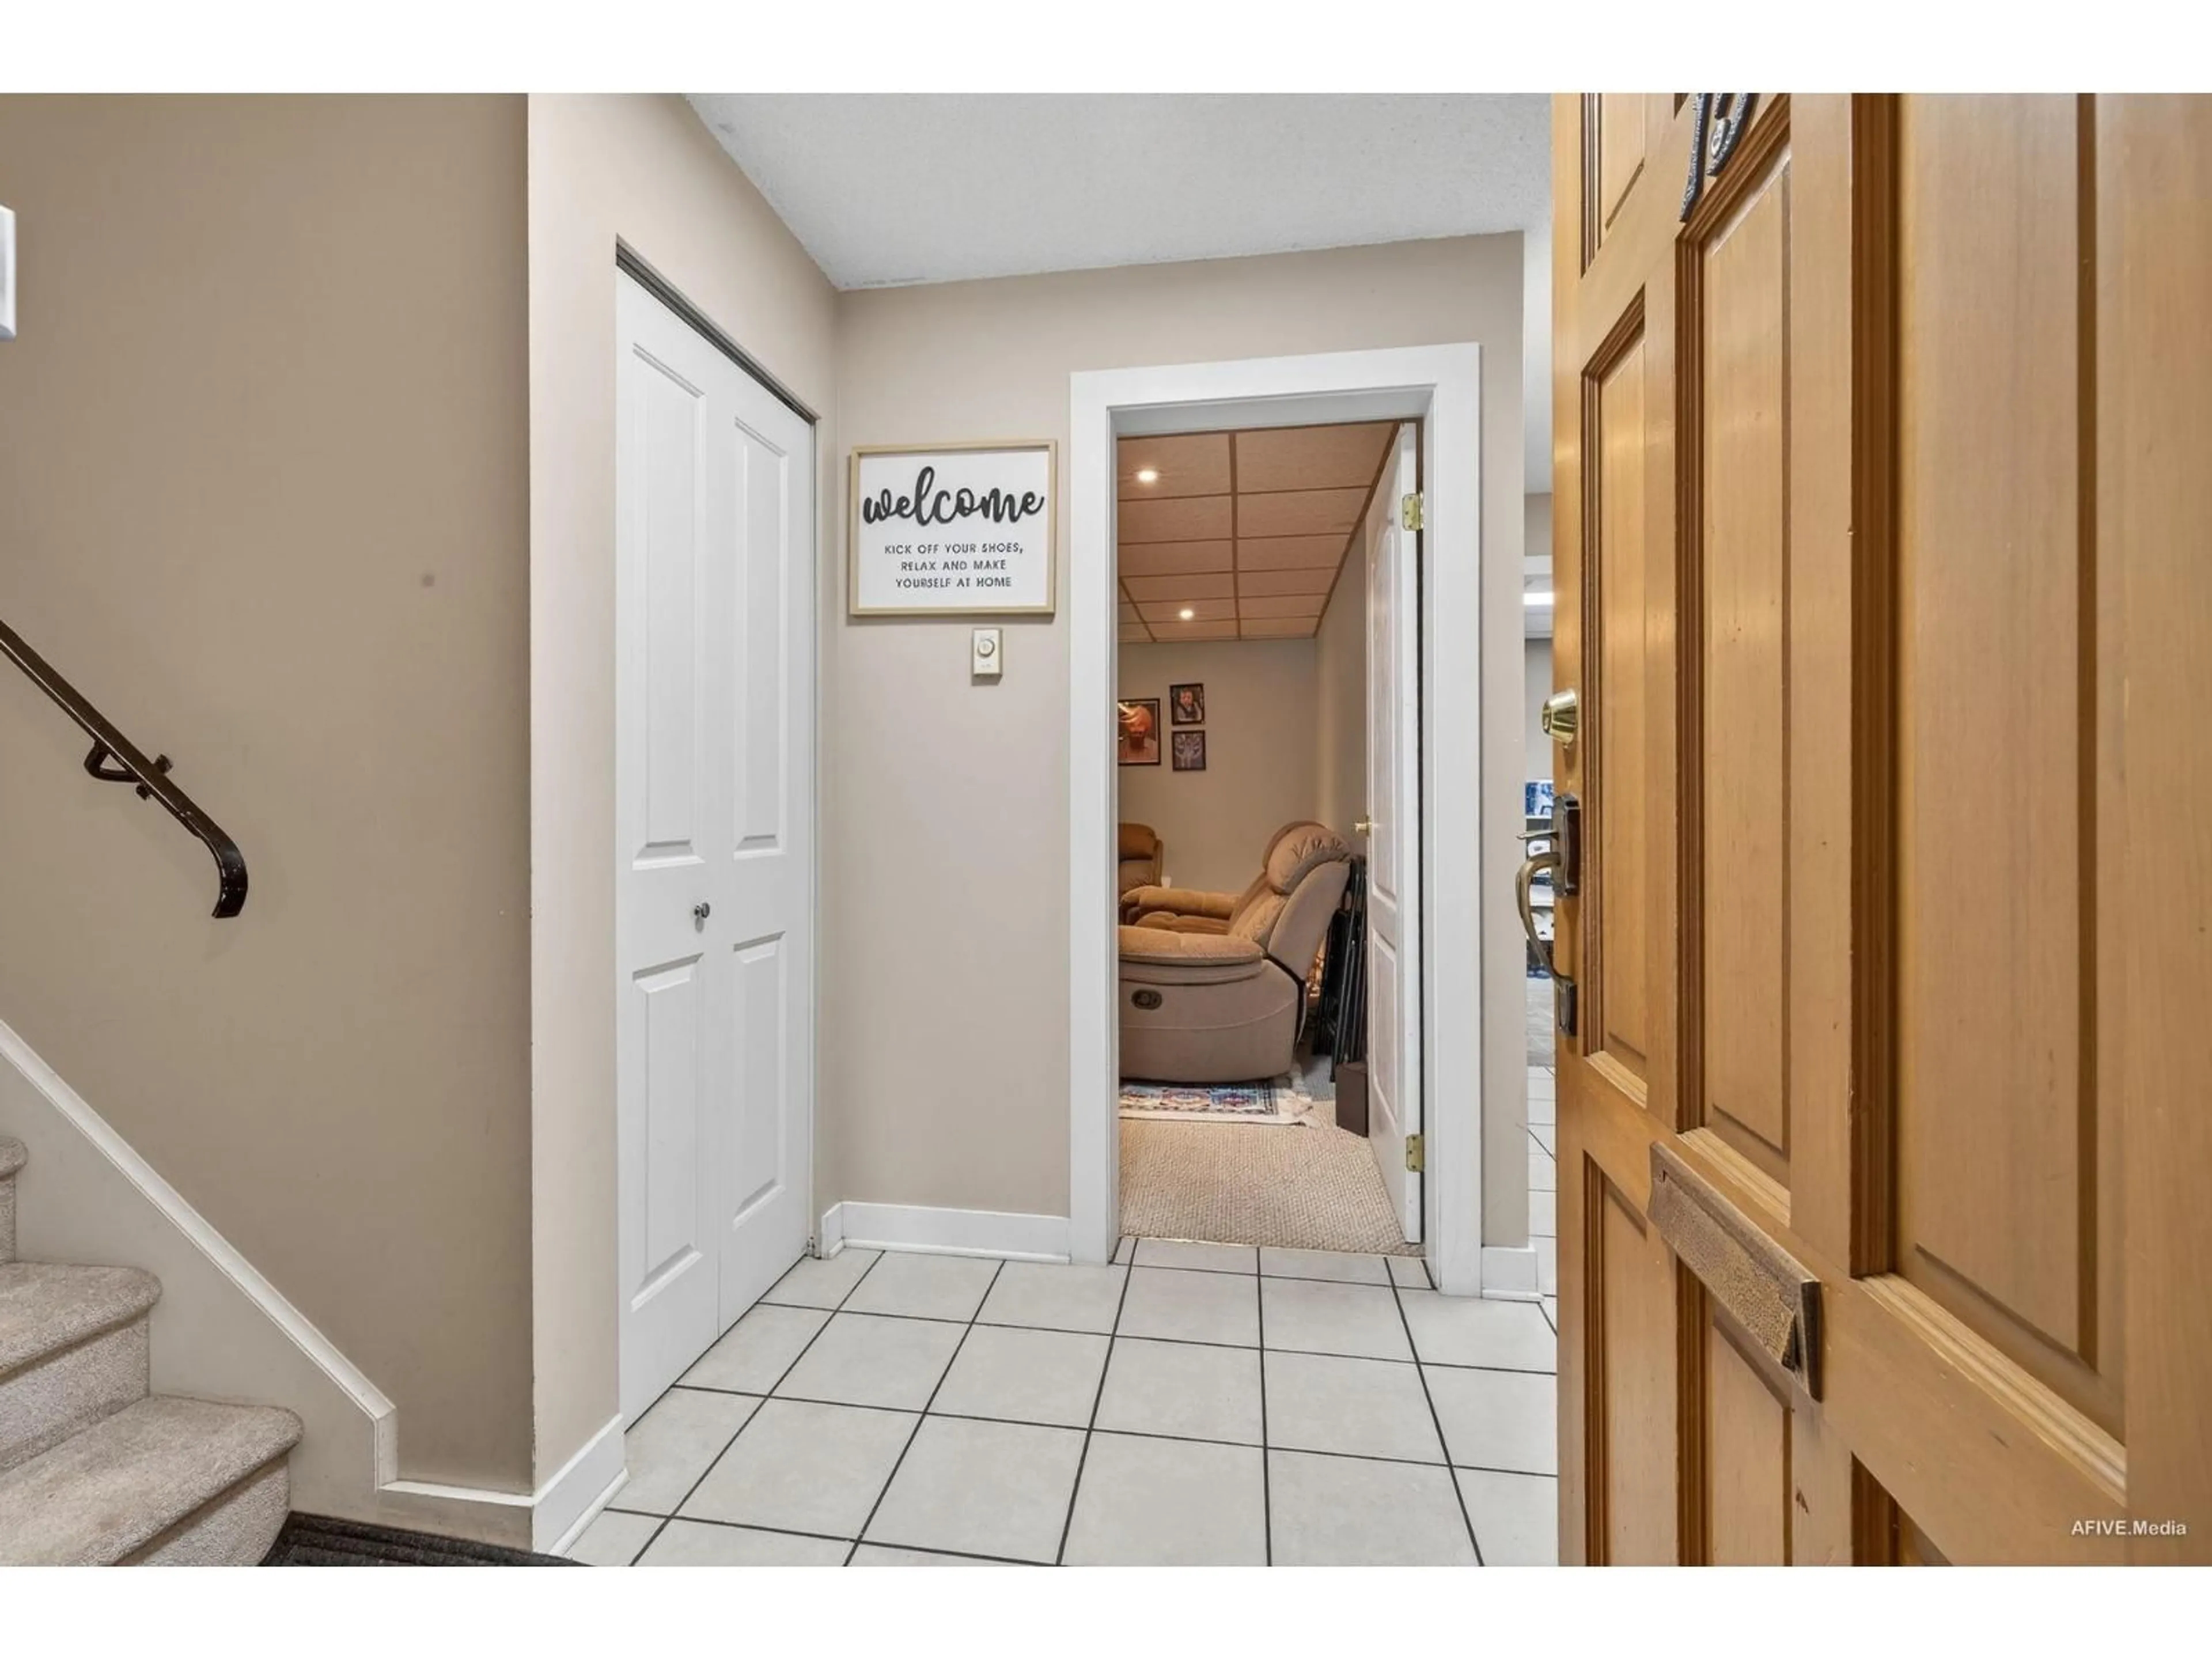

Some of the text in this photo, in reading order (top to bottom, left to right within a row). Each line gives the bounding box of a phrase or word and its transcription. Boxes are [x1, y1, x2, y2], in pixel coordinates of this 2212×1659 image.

[863, 465, 1044, 527] welcome
[884, 542, 1024, 555] KICK OFF YOUR SHOES,
[901, 559, 1006, 571] RELAX AND MAKE
[895, 577, 1012, 589] YOURSELF AT HOME
